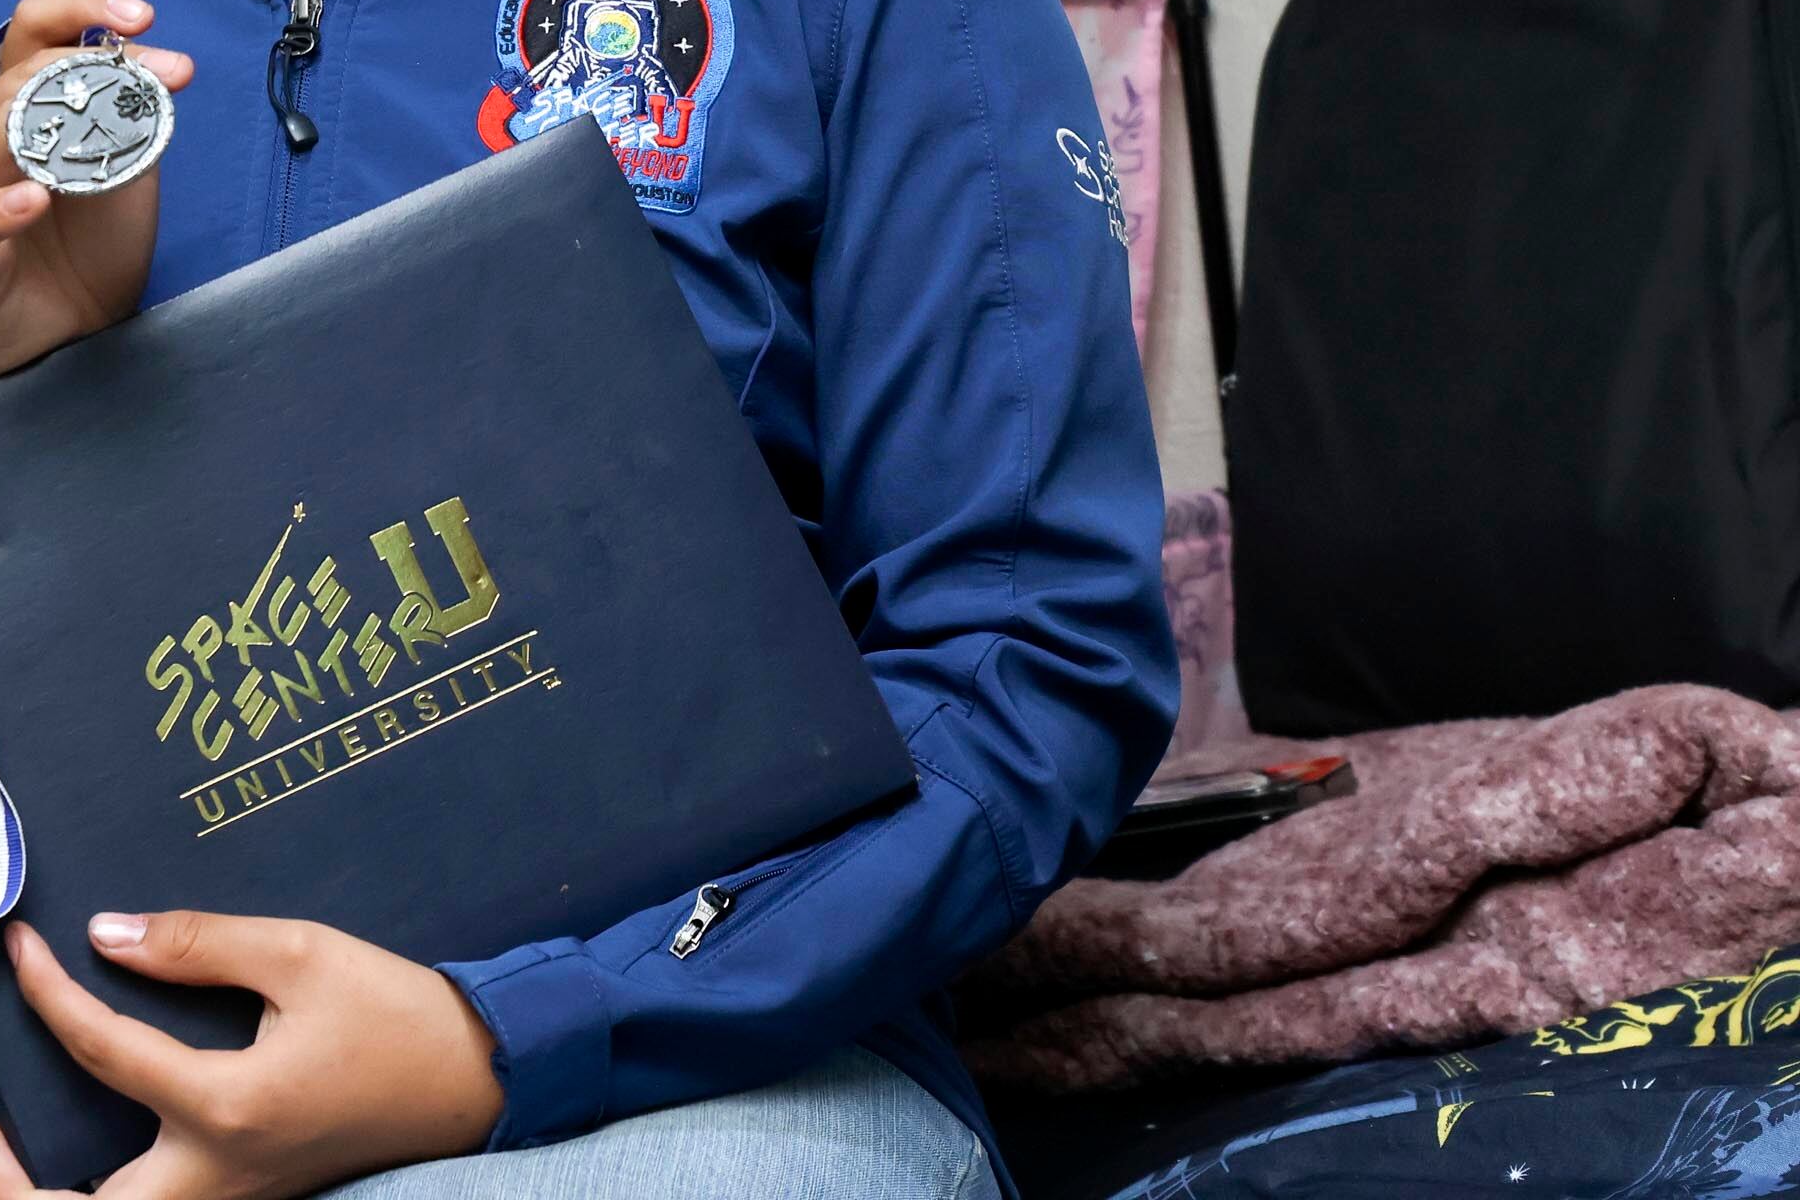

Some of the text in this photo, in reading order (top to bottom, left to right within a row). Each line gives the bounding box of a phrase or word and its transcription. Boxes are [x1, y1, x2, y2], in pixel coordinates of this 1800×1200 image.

[525, 80, 634, 125] SPACE
[647, 94, 696, 148] U
[611, 147, 689, 182] EYOND
[632, 183, 695, 206] OUSTON
[146, 524, 351, 742] SPACE
[191, 496, 500, 762] CENTER U
[194, 643, 535, 823] UNIVERSITY
